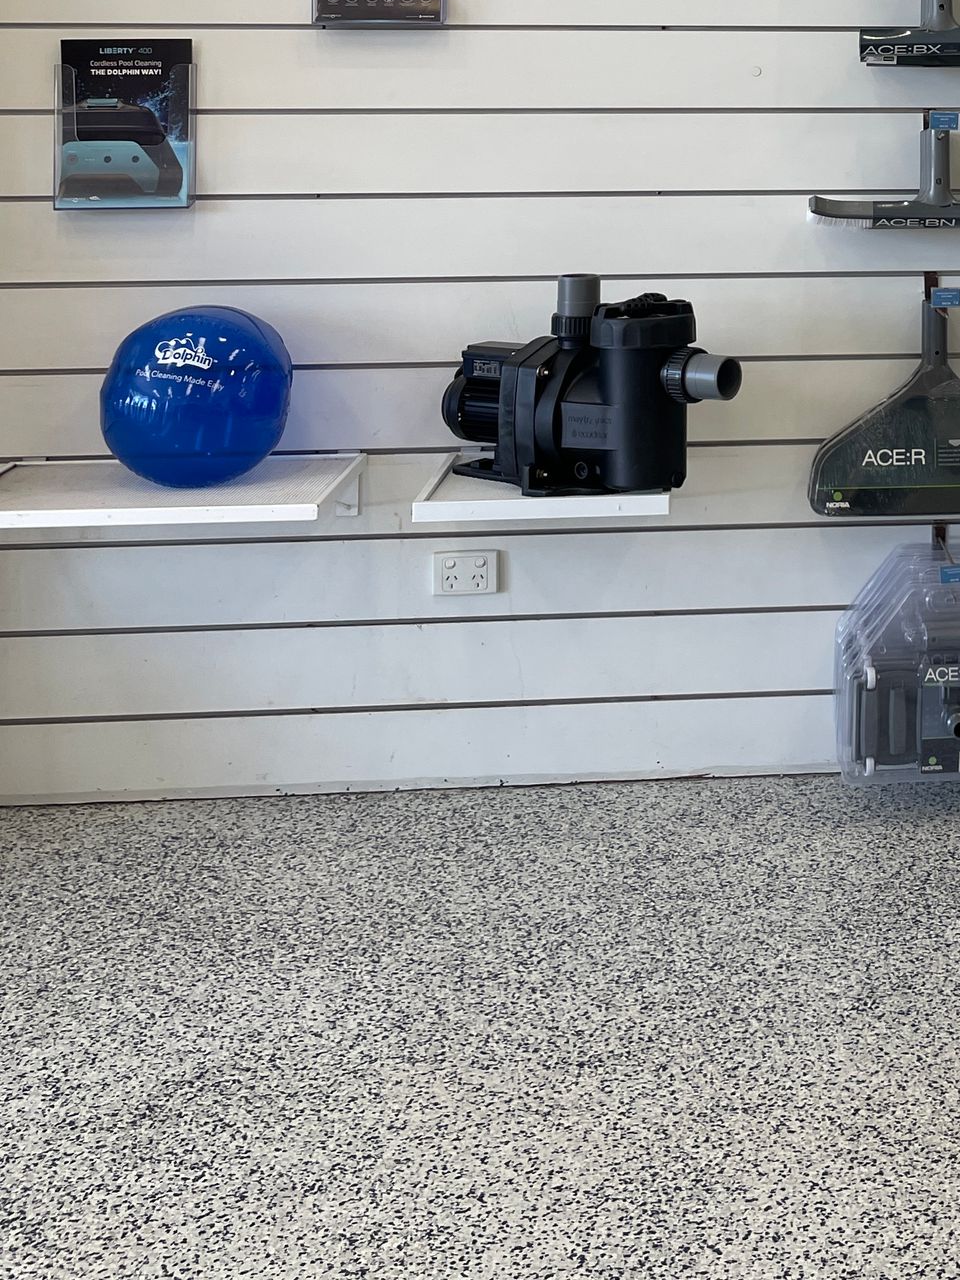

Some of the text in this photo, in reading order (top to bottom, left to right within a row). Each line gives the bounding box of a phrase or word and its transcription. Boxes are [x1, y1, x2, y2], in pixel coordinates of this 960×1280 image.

[863, 44, 942, 55] ACE:BX
[134, 60, 162, 68] Cleaning
[875, 218, 956, 228] ACE:BN
[161, 347, 213, 368] Dolphin
[135, 368, 150, 379] Poo
[151, 370, 183, 383] Cleaning
[183, 375, 206, 387] Made
[862, 448, 926, 466] ACE:R
[826, 501, 850, 509] NORIA
